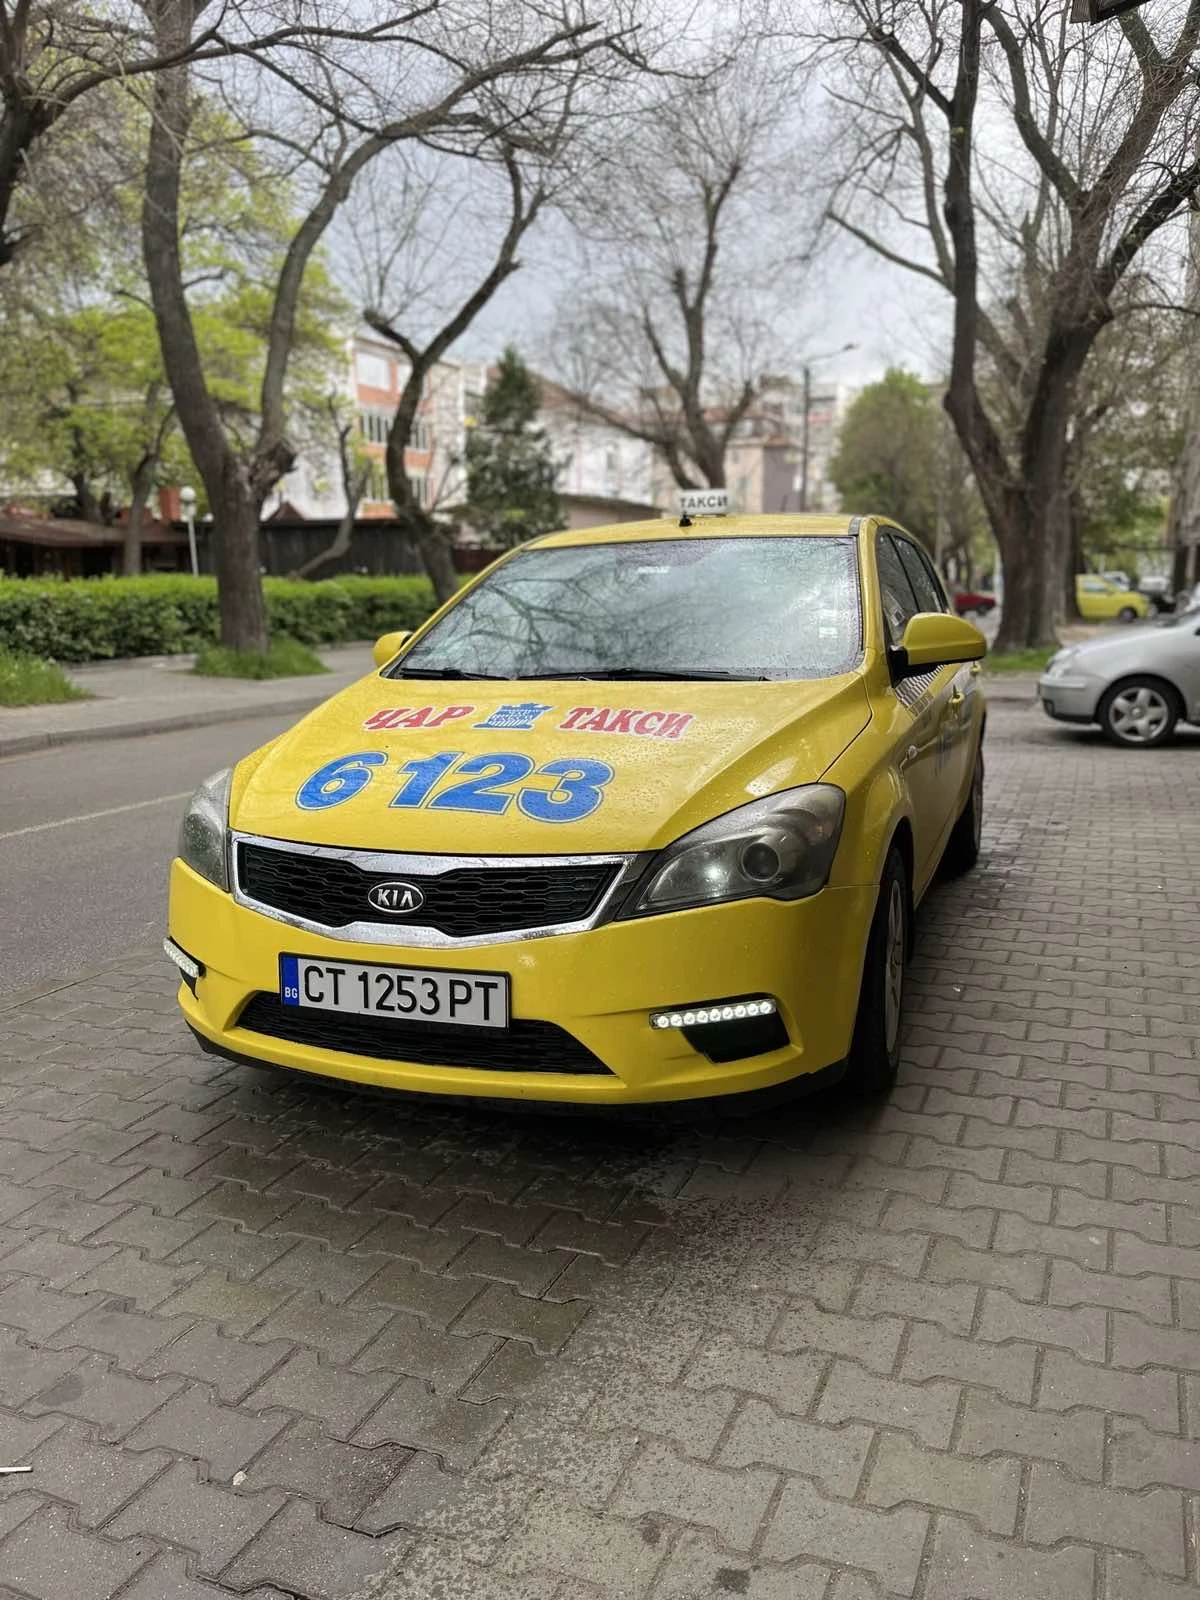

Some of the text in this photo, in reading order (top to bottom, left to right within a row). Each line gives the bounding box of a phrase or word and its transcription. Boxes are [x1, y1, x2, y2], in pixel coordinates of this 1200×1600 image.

[679, 495, 729, 509] ТАКСИ
[559, 706, 694, 740] ТАКСИ
[377, 888, 414, 908] KIA
[284, 986, 299, 999] BG
[303, 965, 499, 1021] CT 1253 PT
